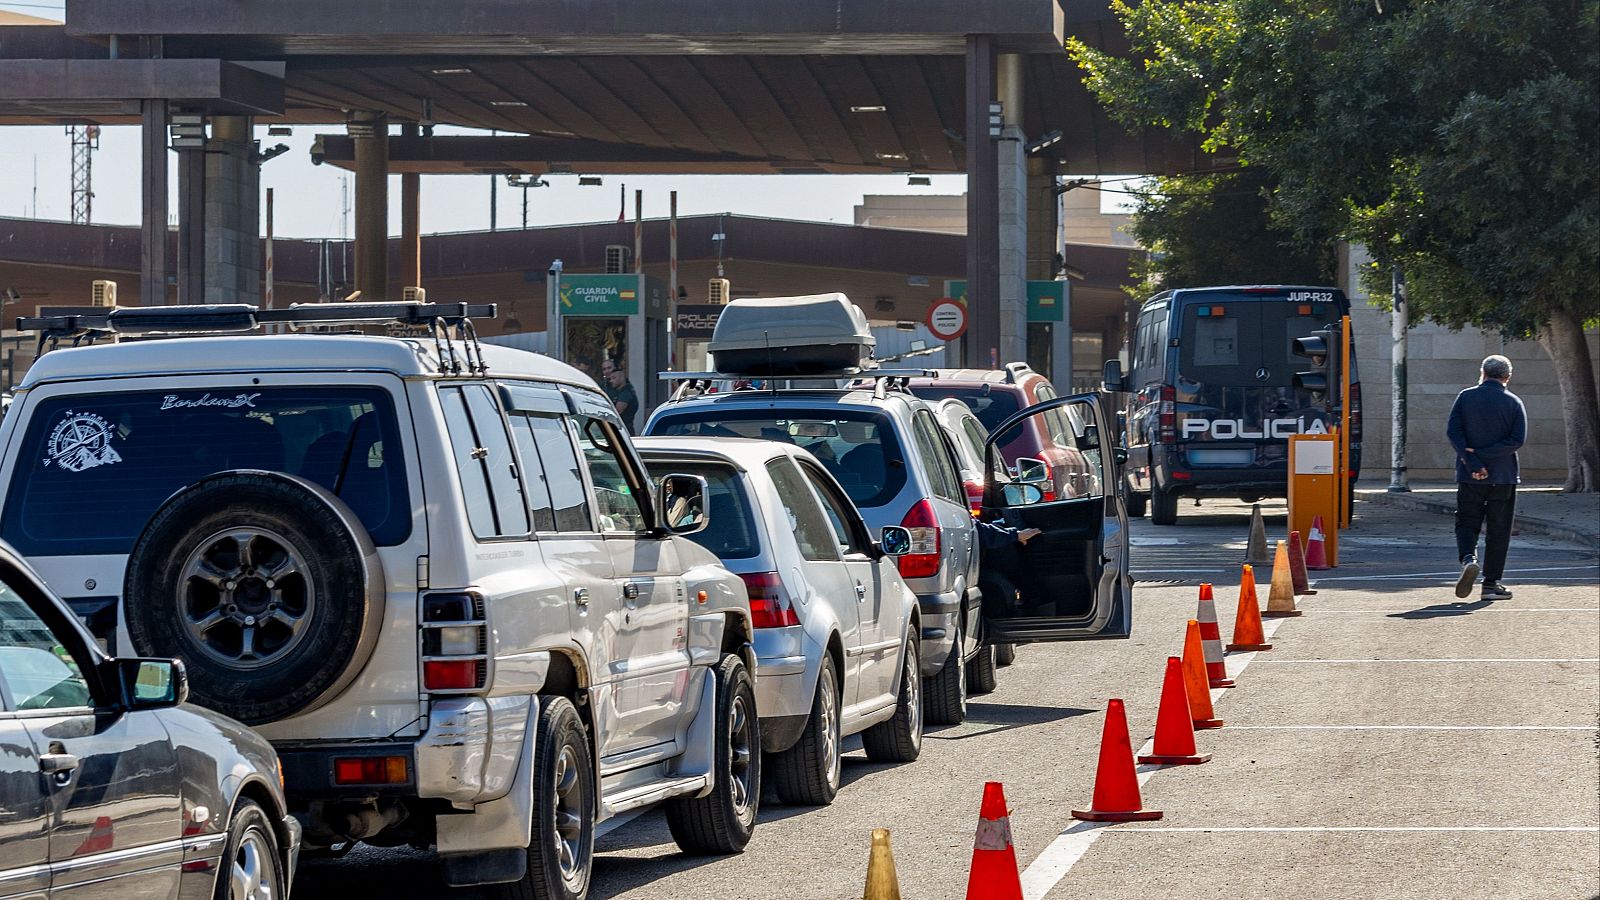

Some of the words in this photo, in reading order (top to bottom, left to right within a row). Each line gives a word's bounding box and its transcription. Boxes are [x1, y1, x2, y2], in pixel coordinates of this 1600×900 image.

[575, 287, 618, 295] GUARDIA
[584, 295, 609, 303] CIVIL
[1287, 291, 1333, 302] JUIP-R32
[677, 314, 720, 322] POLIC
[677, 321, 717, 329] NACIO
[1182, 415, 1328, 439] POLICÍA
